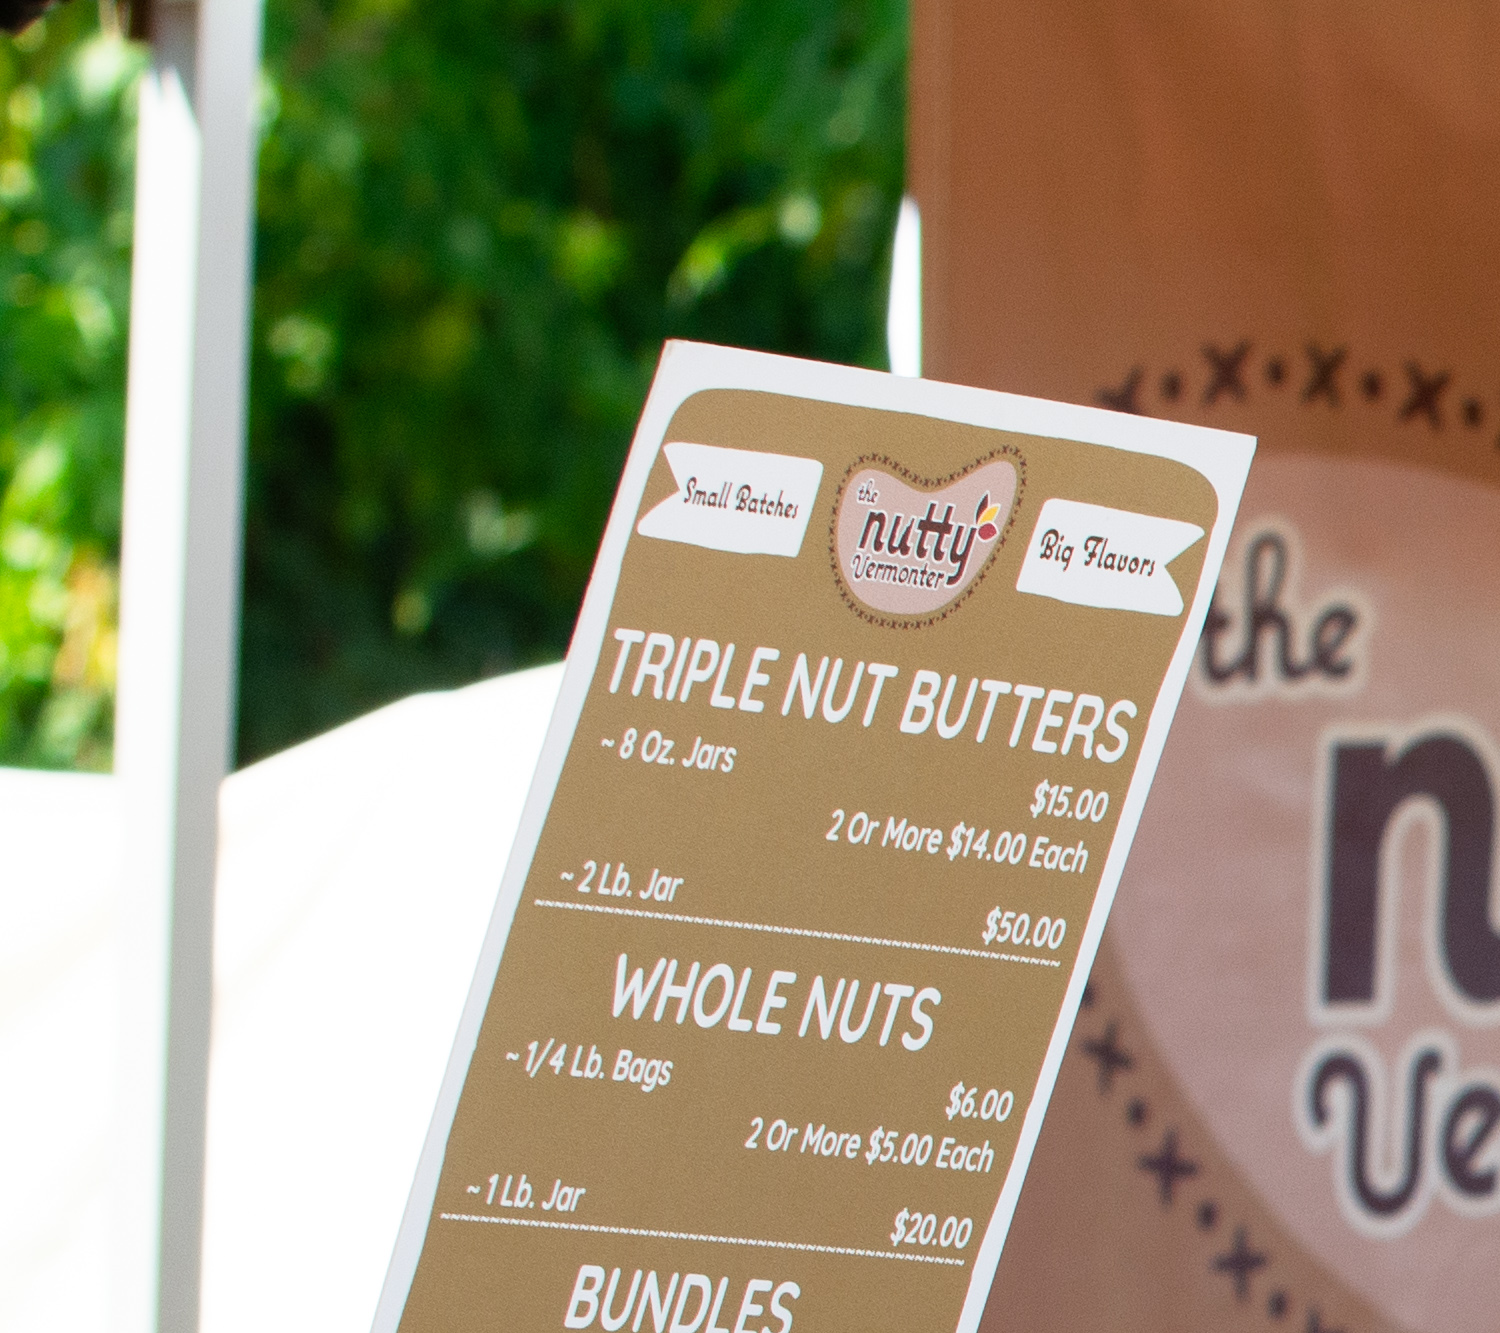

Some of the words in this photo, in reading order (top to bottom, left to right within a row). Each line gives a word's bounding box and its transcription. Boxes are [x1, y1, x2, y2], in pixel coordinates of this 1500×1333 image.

[684, 477, 732, 508] Small
[736, 485, 798, 518] Batches
[858, 480, 878, 503] the
[859, 502, 977, 585] nutty
[1040, 529, 1074, 571] Big
[1084, 536, 1155, 576] Flavors
[852, 556, 943, 588] Vermonter
[1202, 529, 1361, 688] the
[610, 628, 780, 712] TRIPLE
[782, 653, 898, 727] NUT
[900, 670, 1137, 762] BUTTERS
[620, 728, 637, 759] 8
[641, 730, 674, 765] Oz.
[682, 737, 736, 772] Jars
[1030, 779, 1108, 822] $15.00
[826, 809, 844, 840] 2
[848, 812, 880, 844] Or
[882, 817, 942, 853] More
[947, 822, 1026, 864] $14.00
[1029, 836, 1088, 873] Each
[578, 860, 596, 892] 2
[598, 863, 632, 897] Lb.
[639, 869, 684, 902] Jar
[982, 906, 1066, 949] $50.00
[613, 953, 796, 1034] WHOLE
[799, 976, 941, 1050] NUTS
[526, 1038, 566, 1078] 1/4
[570, 1045, 604, 1078] Lb.
[612, 1049, 673, 1092] Bags
[946, 1081, 1013, 1121] $6.00
[745, 1117, 763, 1148] 2
[767, 1119, 798, 1151] Or
[800, 1123, 861, 1158] More
[865, 1126, 932, 1165] $5.00
[936, 1137, 994, 1172] Each
[487, 1174, 499, 1204] 1
[500, 1175, 534, 1208] Lb.
[542, 1179, 586, 1211] Jar
[890, 1208, 972, 1248] $20.00
